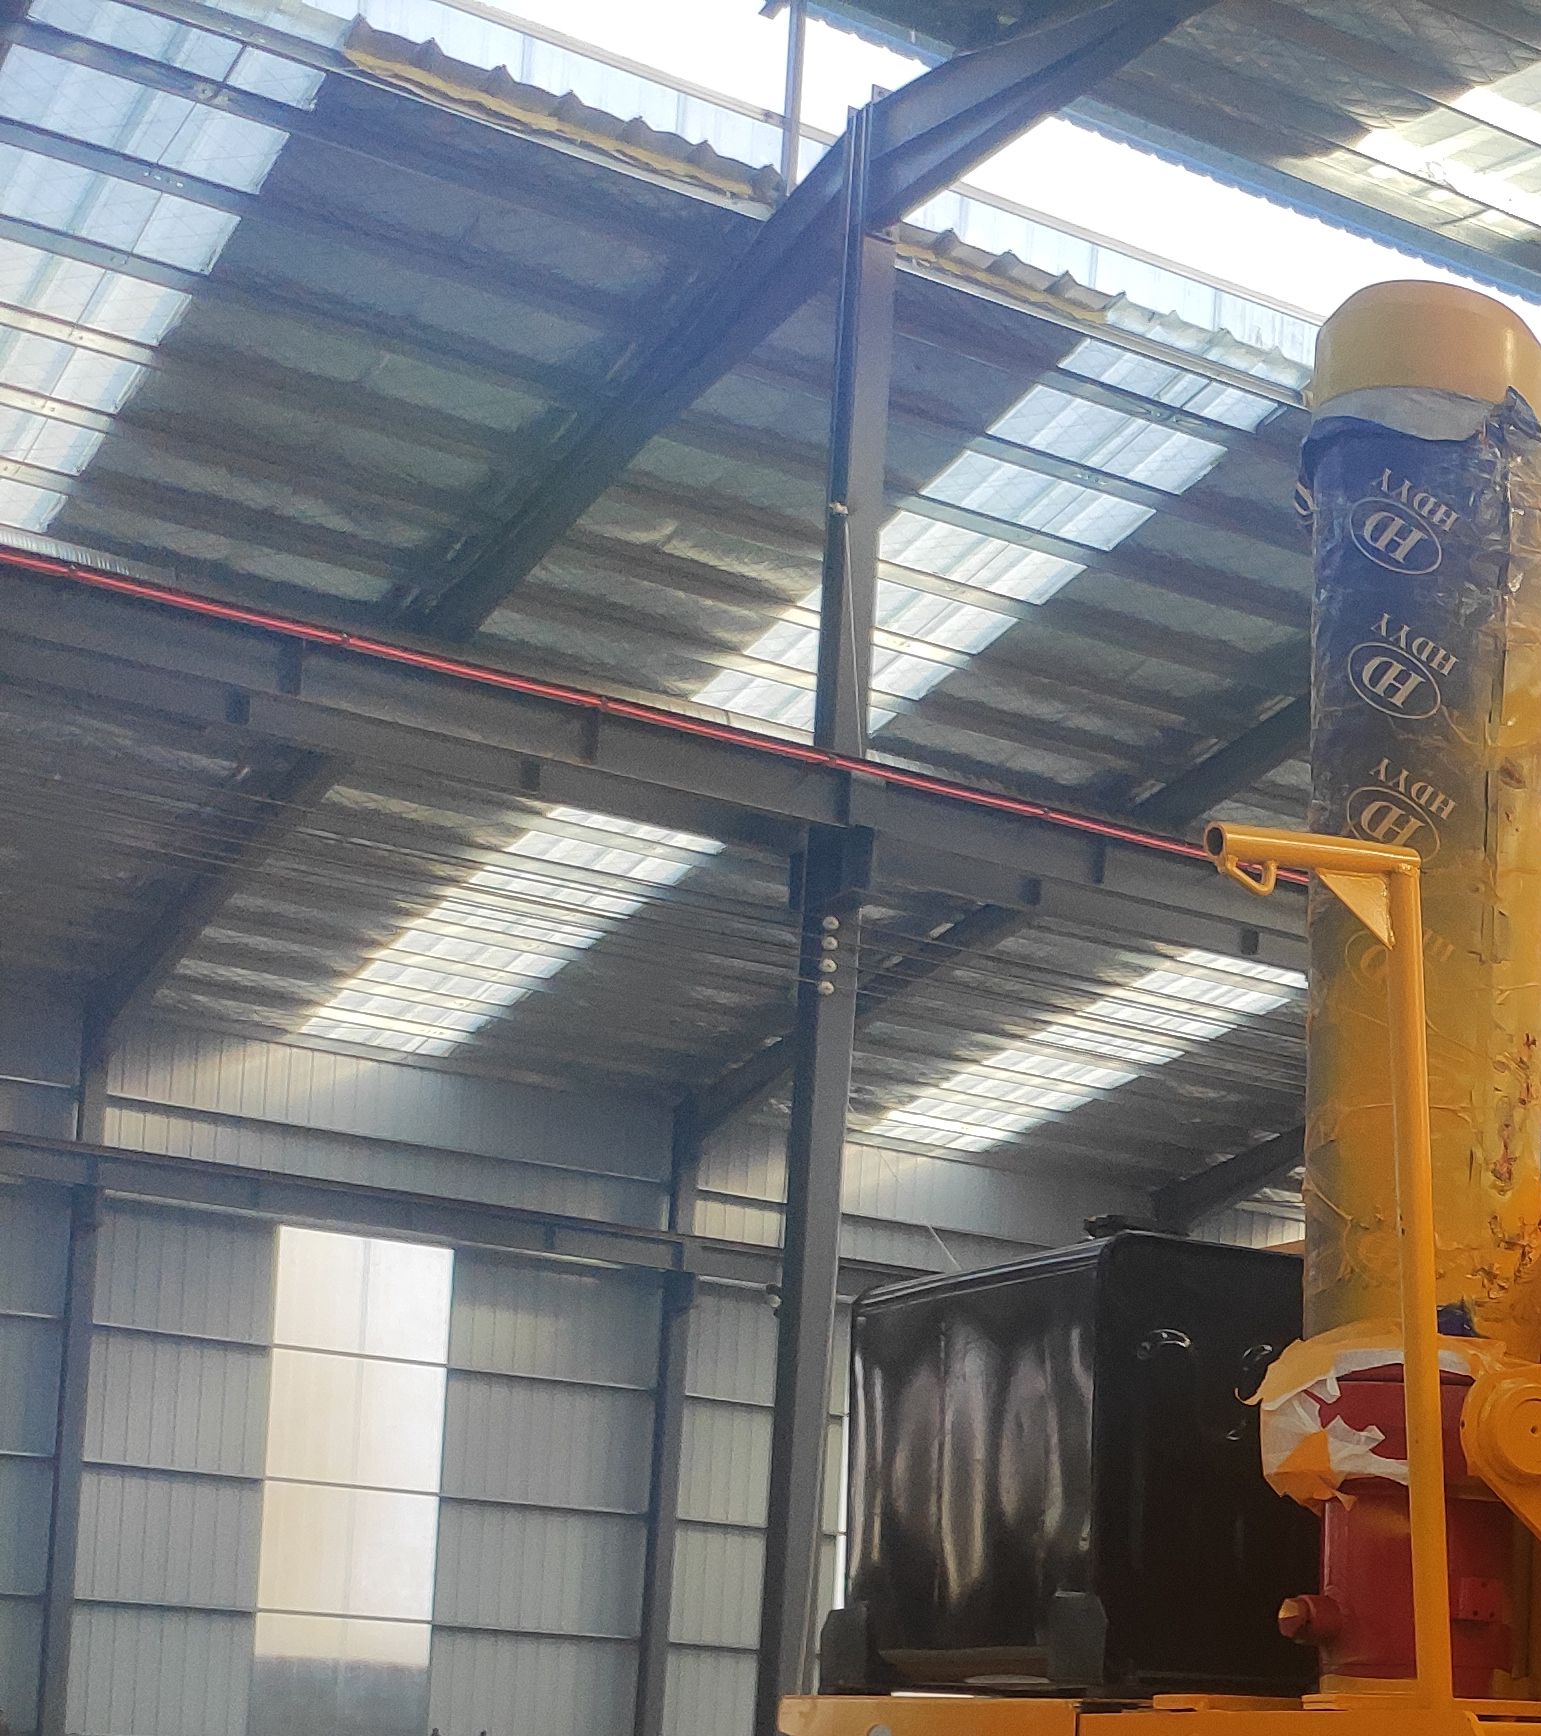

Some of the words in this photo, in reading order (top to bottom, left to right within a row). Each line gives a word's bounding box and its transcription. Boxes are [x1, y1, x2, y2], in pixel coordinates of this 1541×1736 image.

[1371, 467, 1461, 533] HDYY
[1369, 612, 1460, 677] HDYY
[1369, 756, 1457, 821] HDYY
